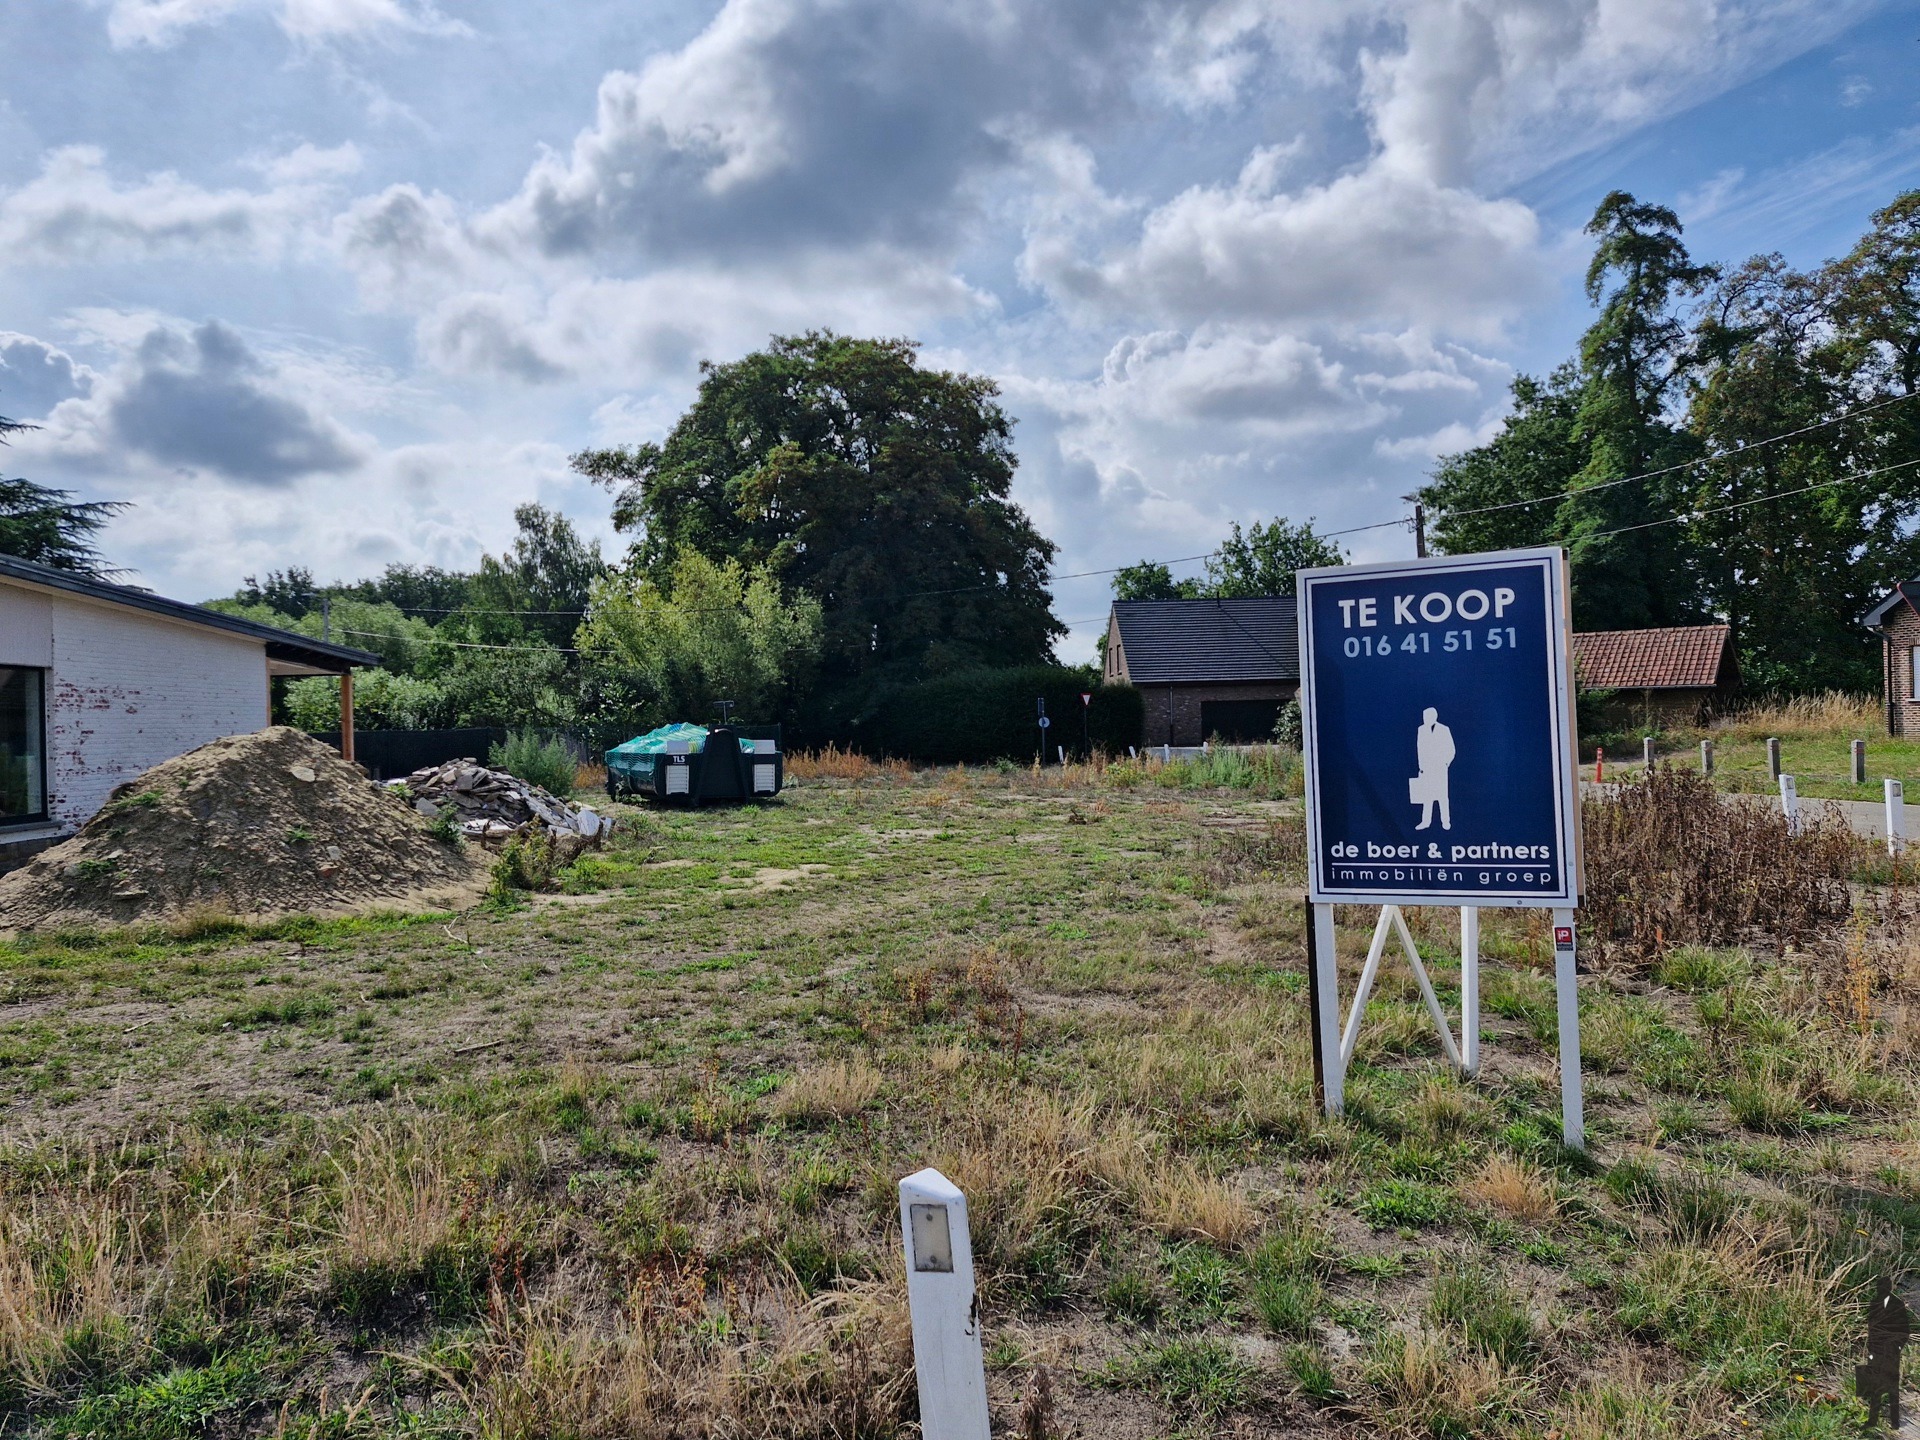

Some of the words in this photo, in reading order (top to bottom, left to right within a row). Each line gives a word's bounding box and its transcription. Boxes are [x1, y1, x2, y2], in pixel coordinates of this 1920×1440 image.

[1338, 598, 1377, 629] TE
[1394, 588, 1515, 625] KOOP
[1344, 635, 1391, 657] 016
[1400, 632, 1430, 654] 41
[1443, 630, 1472, 652] 51
[1486, 627, 1516, 649] 51
[673, 755, 686, 763] TLS
[1331, 841, 1359, 858] de
[1367, 841, 1419, 859] boer
[1428, 843, 1443, 859] &
[1451, 842, 1550, 862] partners
[1331, 867, 1463, 882] immobiliën
[1479, 870, 1551, 884] groep
